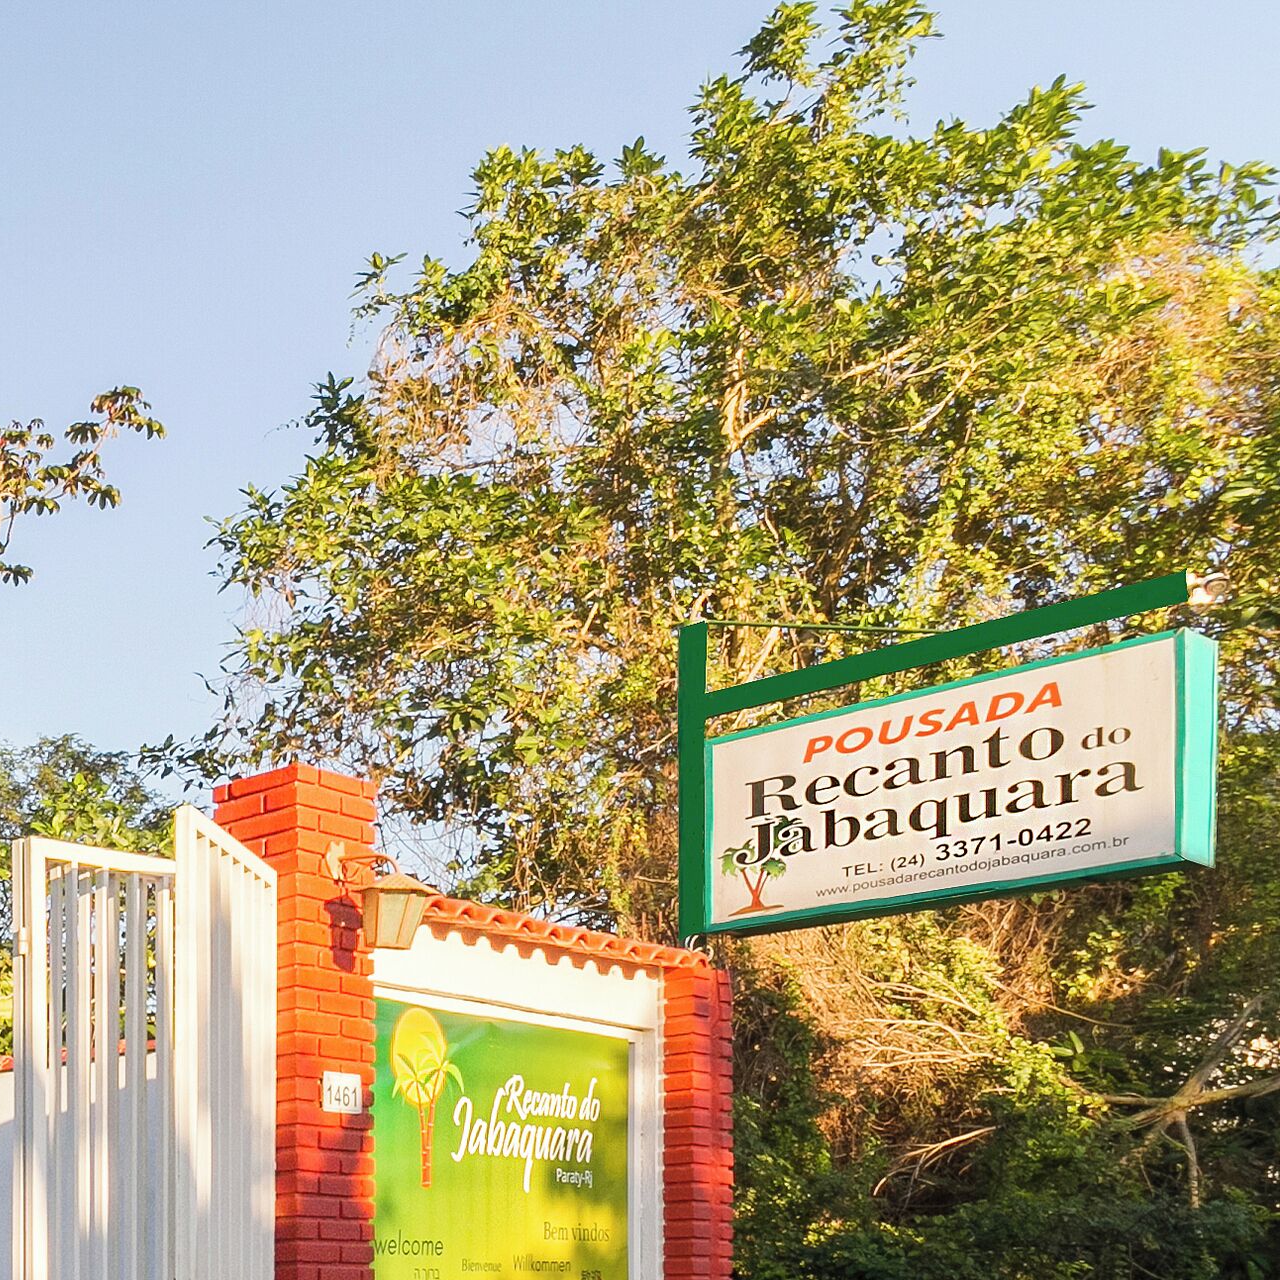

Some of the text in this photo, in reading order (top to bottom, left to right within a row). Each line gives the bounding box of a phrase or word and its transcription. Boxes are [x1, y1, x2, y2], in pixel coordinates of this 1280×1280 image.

[803, 681, 1062, 763] POUSADA
[745, 725, 1132, 820] Recanto do
[738, 759, 1145, 866] Jabaquara
[816, 836, 1130, 897] www.pousadarecantodojabaquara.com.br
[842, 818, 1092, 878] TEL: (24) 3371-0422
[327, 1085, 358, 1107] 1461
[504, 1075, 600, 1121] Recanto do
[451, 1087, 593, 1193] Jabaquara
[374, 1230, 444, 1256] welcome
[543, 1222, 610, 1242] Bem vindos
[462, 1259, 502, 1273] Bienvenue
[513, 1254, 571, 1273] Willkommen
